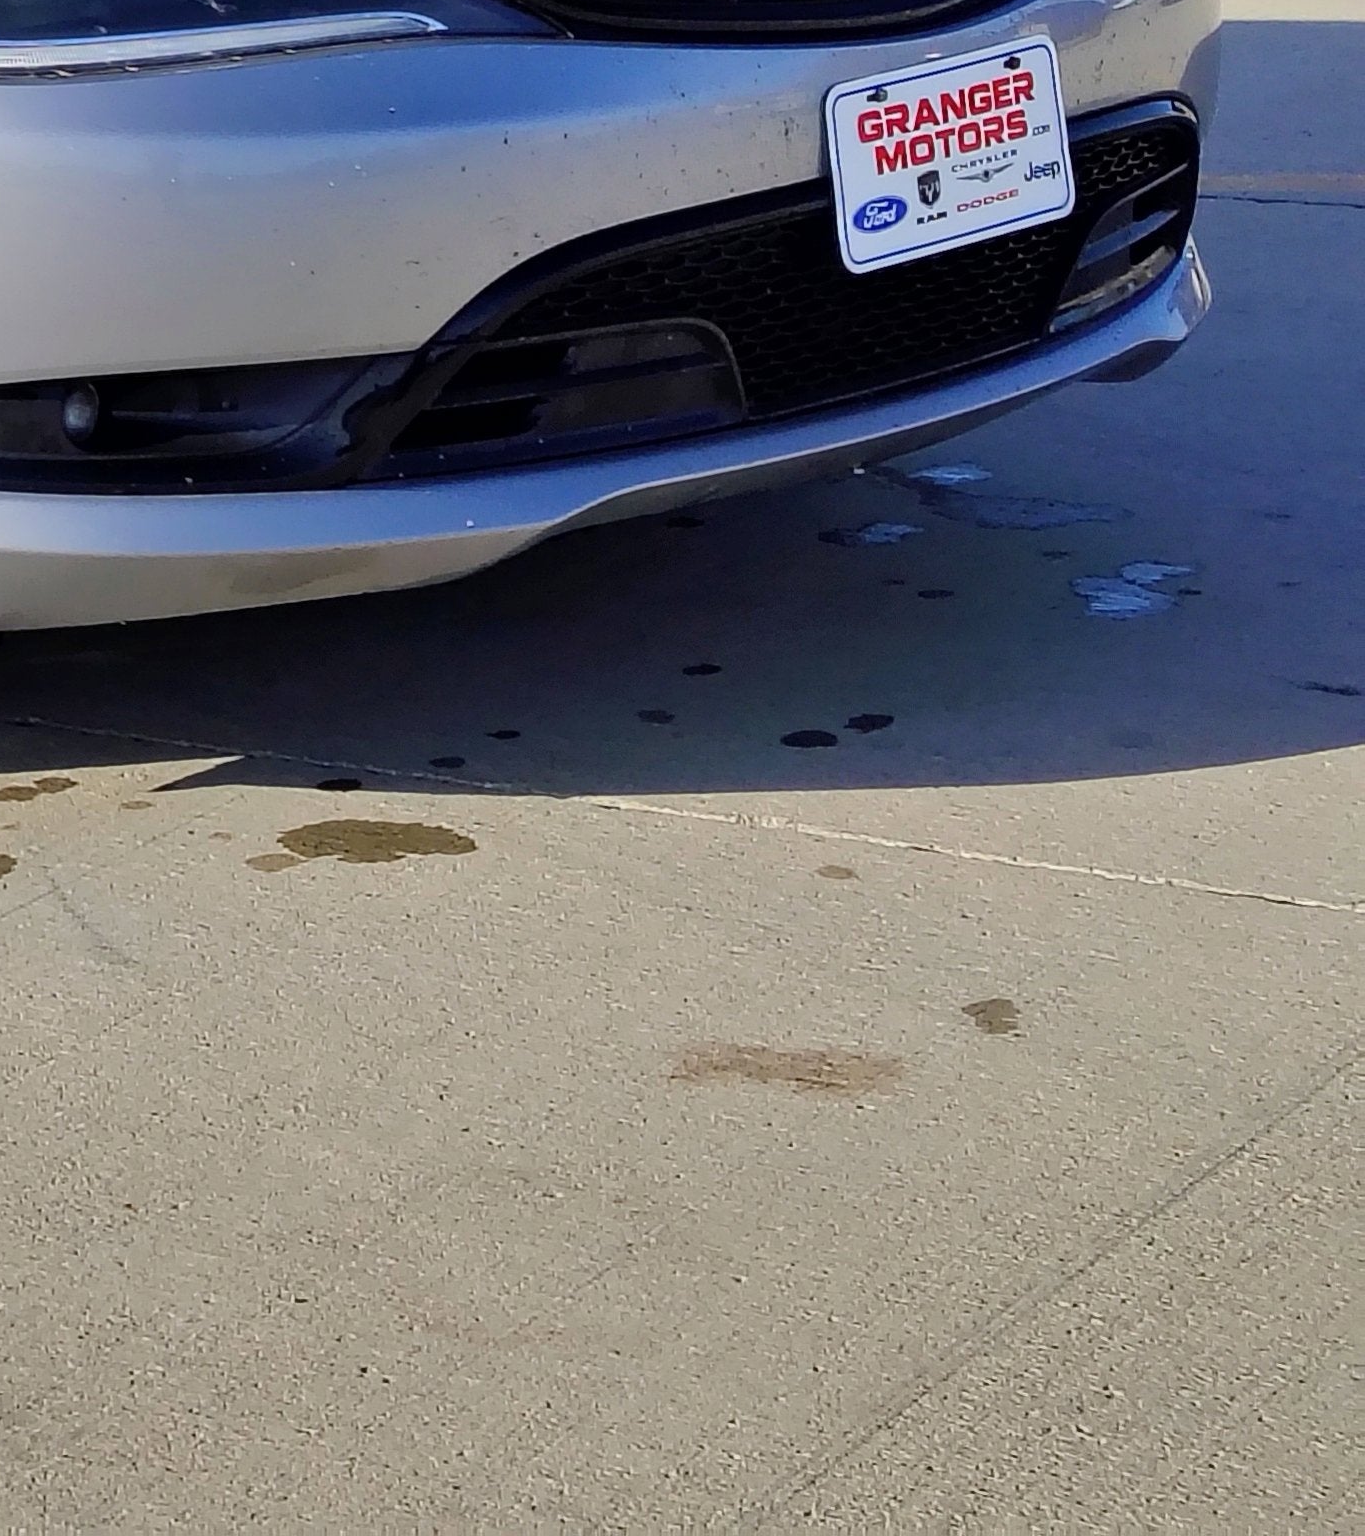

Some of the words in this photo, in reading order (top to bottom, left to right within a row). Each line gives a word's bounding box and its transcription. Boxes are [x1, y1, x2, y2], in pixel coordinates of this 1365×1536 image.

[857, 70, 1035, 143] GRANGER
[874, 109, 1028, 175] MOTORS
[951, 149, 1018, 173] CHRYSLER
[1023, 160, 1061, 182] Jeep
[956, 188, 1019, 212] DODGE
[863, 201, 897, 229] Ford
[916, 211, 948, 225] RAM
